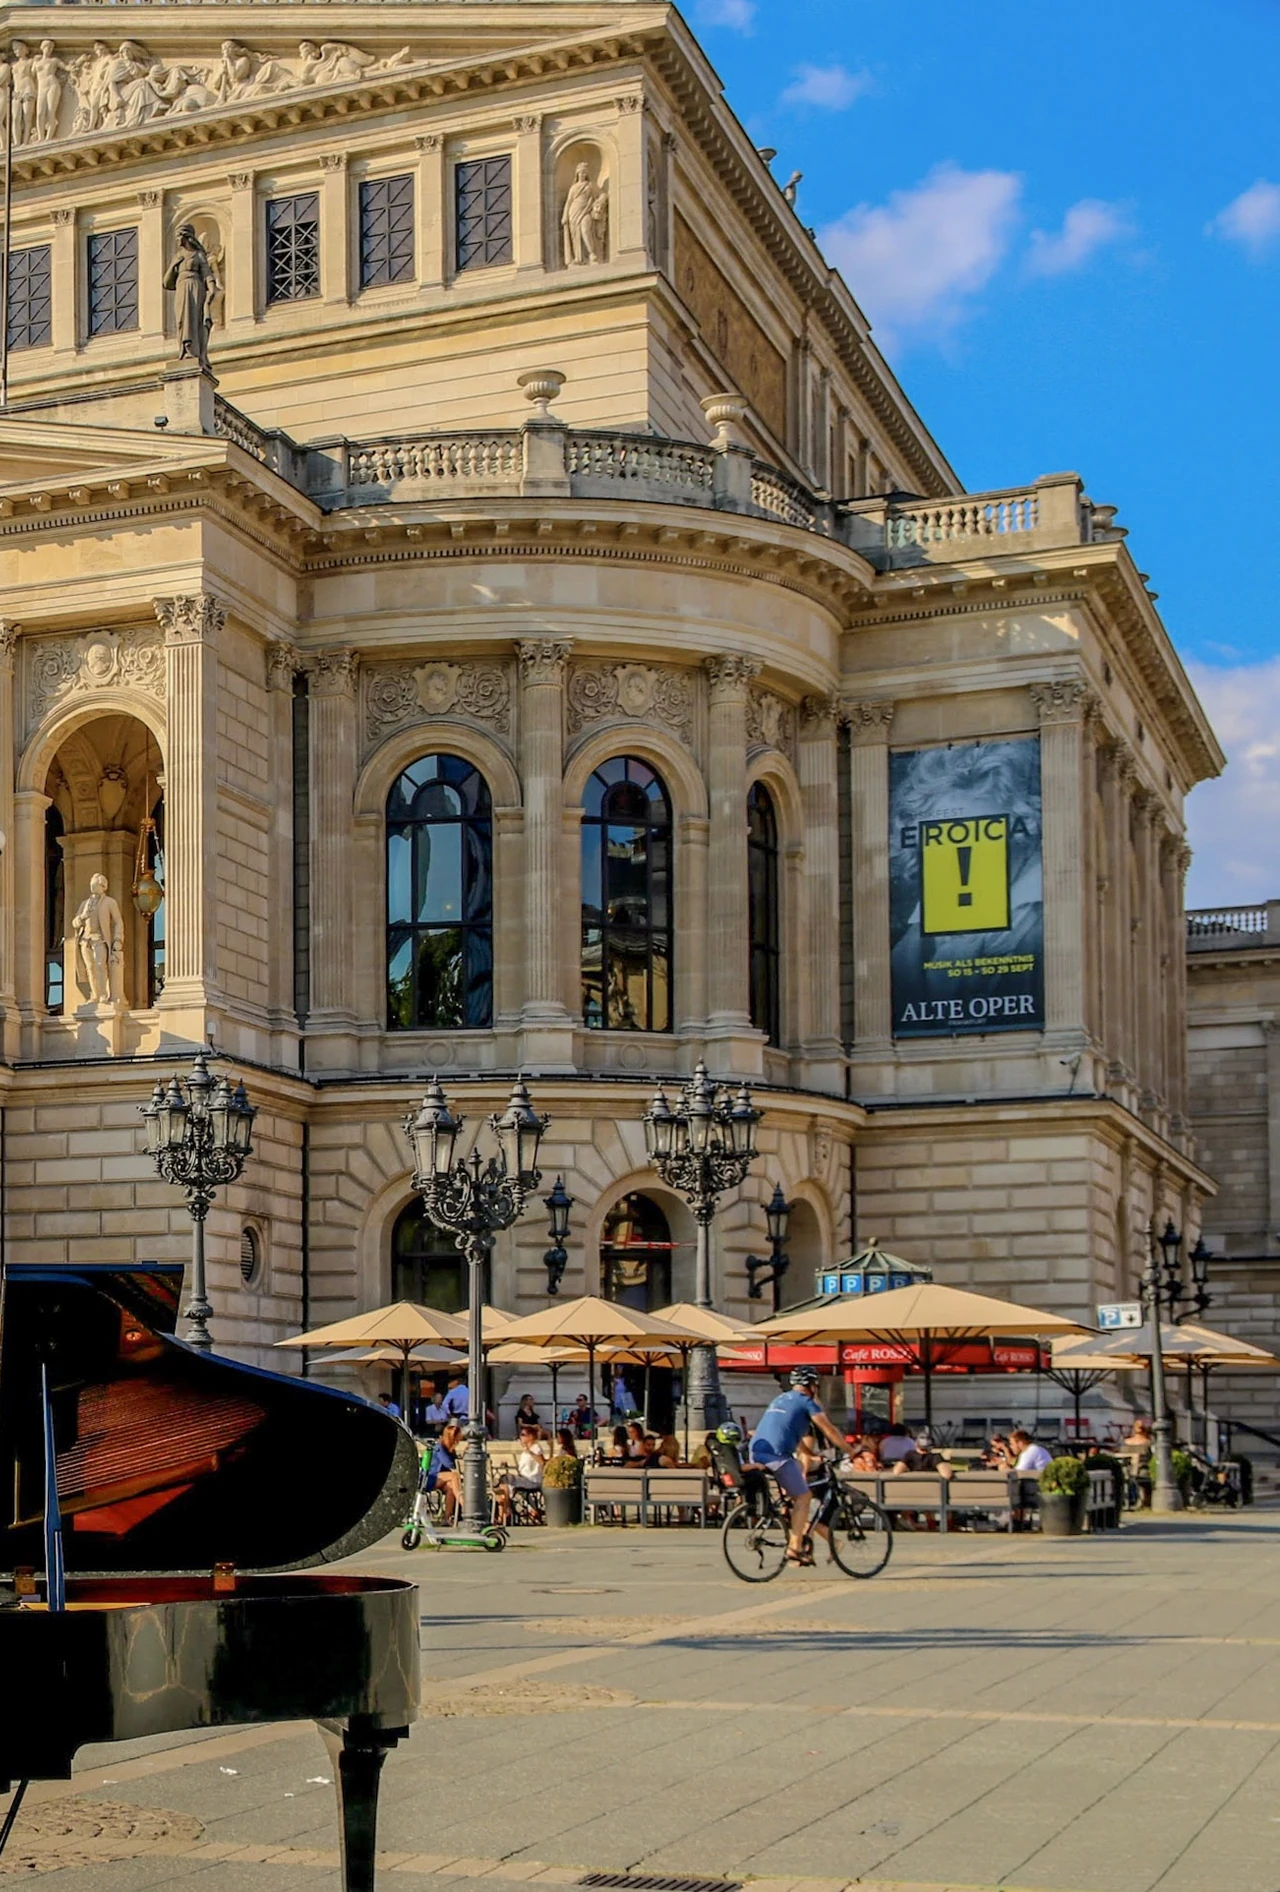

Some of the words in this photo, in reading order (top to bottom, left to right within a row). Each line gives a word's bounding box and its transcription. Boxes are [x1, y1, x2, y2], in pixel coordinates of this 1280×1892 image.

[923, 960, 954, 971] MUSIK
[954, 959, 973, 969] ALS
[974, 954, 1036, 967] BEKENNTNIS
[947, 968, 962, 978] SO
[981, 966, 995, 976] SO
[1010, 963, 1035, 974] SEPT
[900, 999, 965, 1022] ALTE
[969, 994, 1036, 1019] OPER
[846, 1279, 857, 1294] P
[868, 1279, 882, 1293] P
